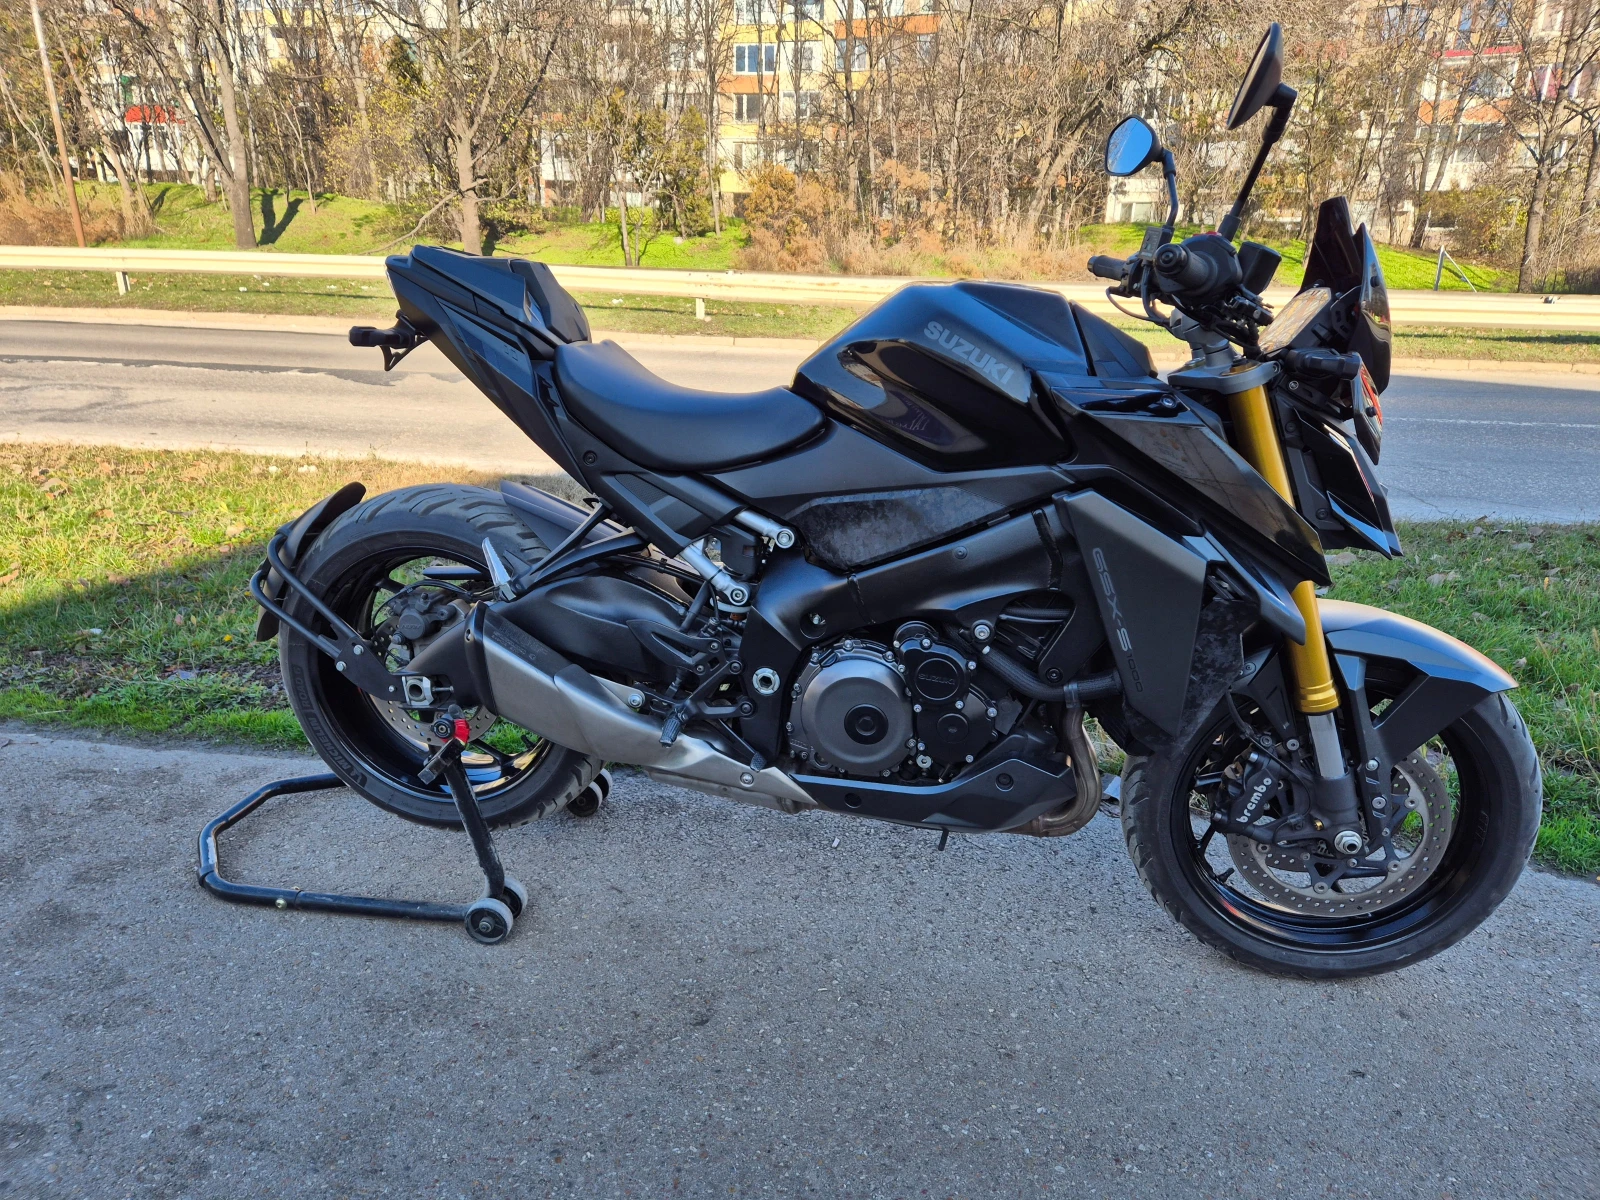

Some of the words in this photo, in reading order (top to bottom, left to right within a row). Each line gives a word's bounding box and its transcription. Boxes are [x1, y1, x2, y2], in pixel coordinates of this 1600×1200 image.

[923, 320, 1015, 385] SUZUKI
[295, 677, 312, 708] ROAD
[308, 717, 352, 770] MICHELIN
[1236, 777, 1272, 823] brembo
